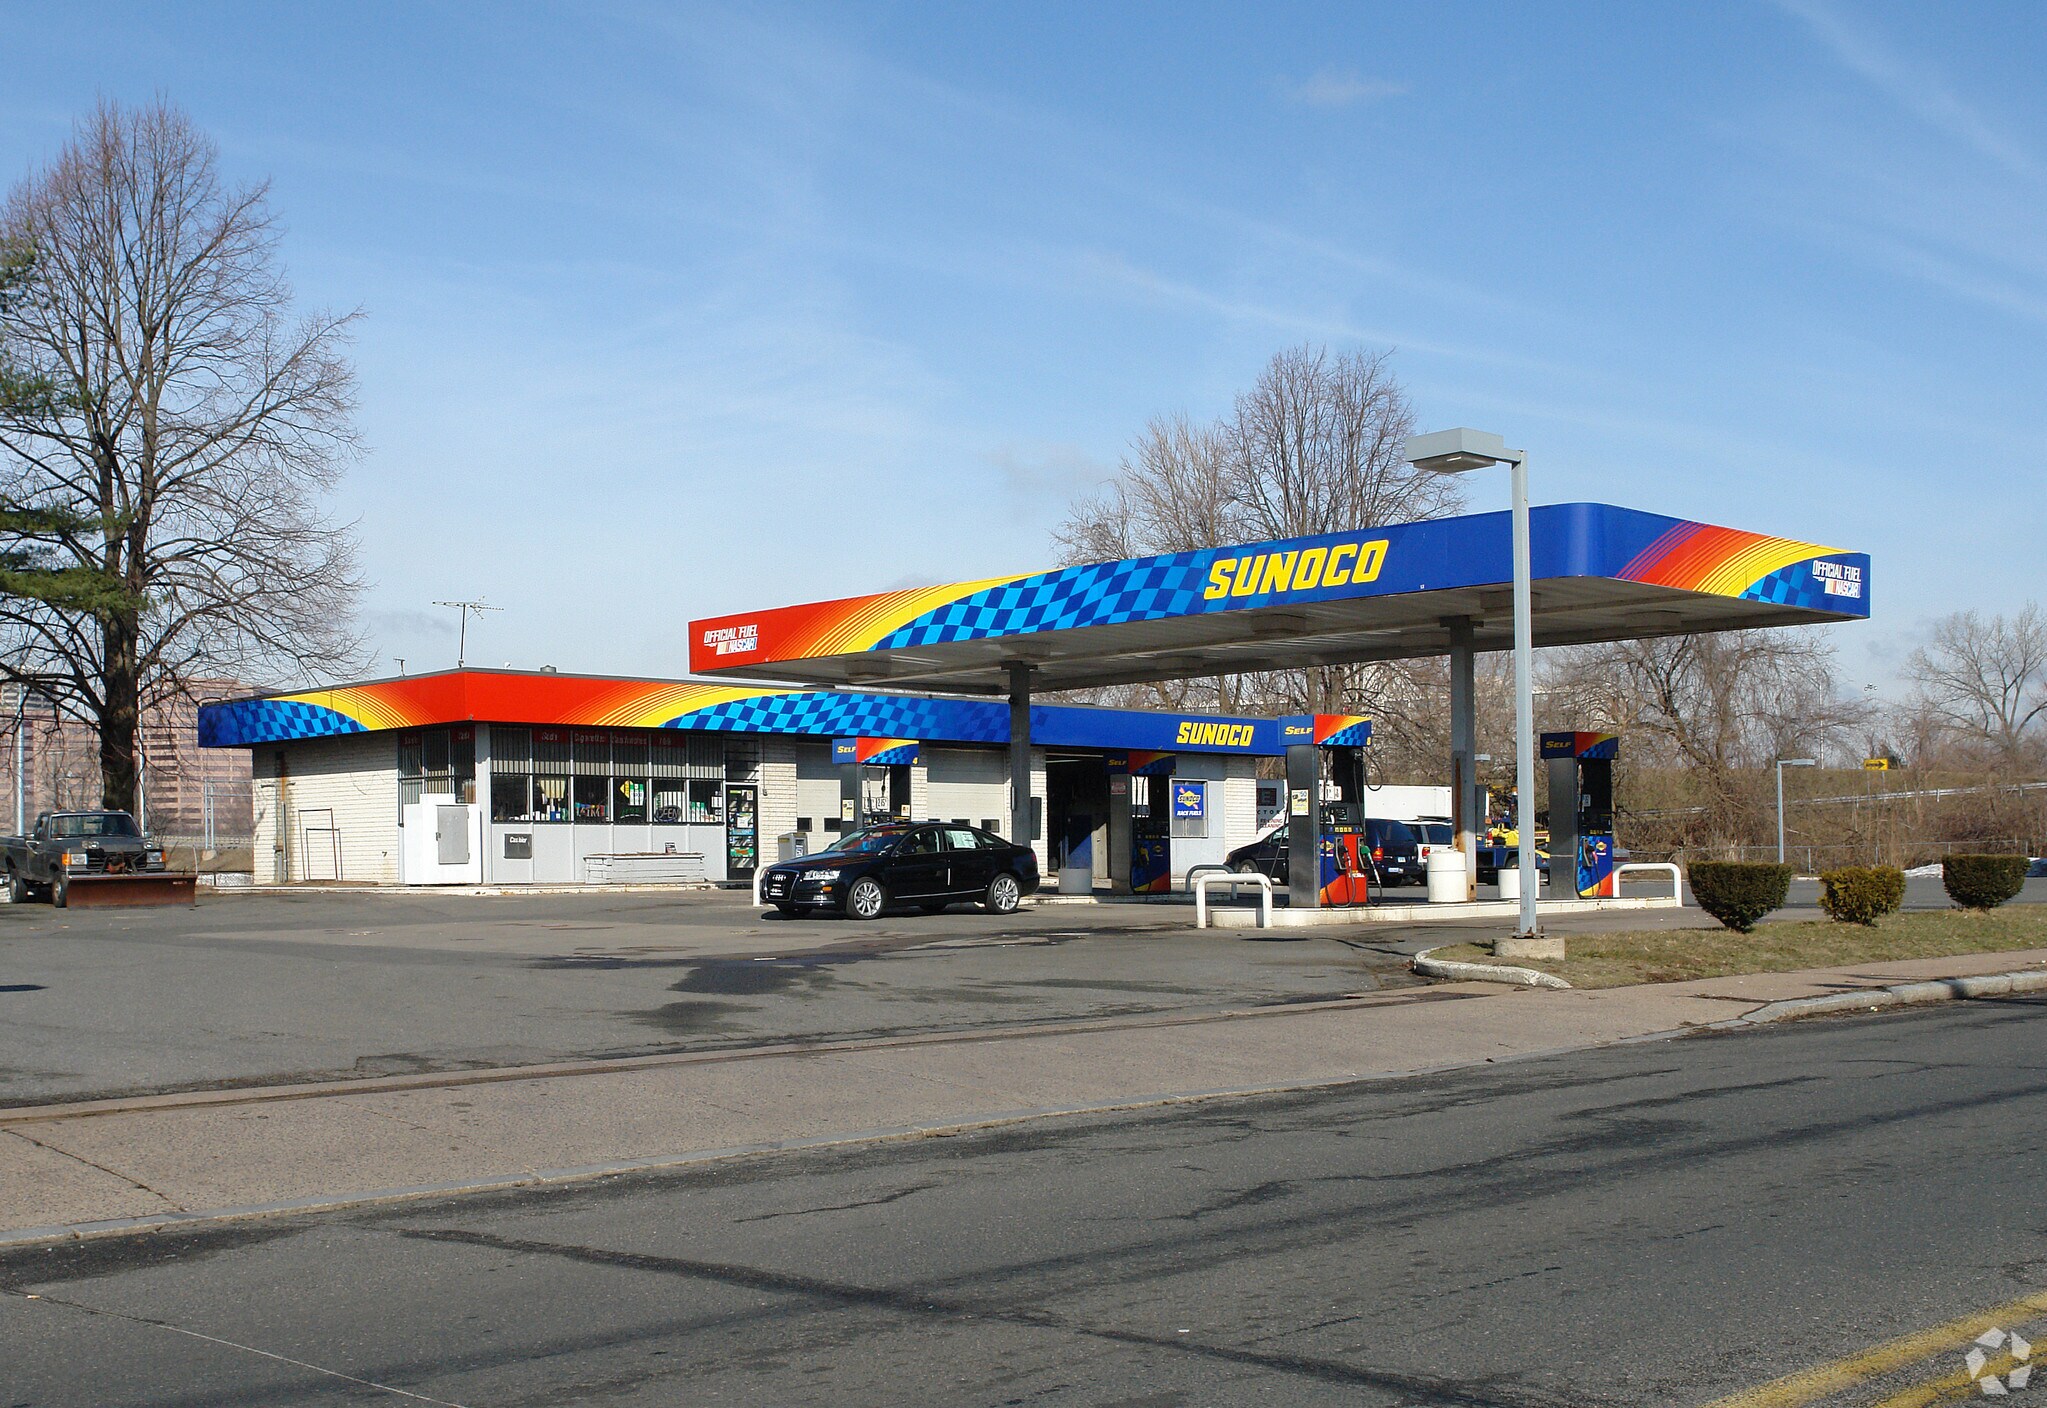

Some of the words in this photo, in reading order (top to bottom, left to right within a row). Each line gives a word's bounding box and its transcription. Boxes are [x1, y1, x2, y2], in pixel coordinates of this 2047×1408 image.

[1204, 539, 1390, 601] SUNOCO
[1812, 560, 1843, 580] OFFICIAL
[1843, 565, 1861, 582] FUEL
[704, 627, 737, 643] OFFICIAL
[738, 624, 758, 639] FUEL
[728, 637, 758, 652] NASCAR
[1176, 721, 1254, 747] SUNOCO
[837, 745, 856, 754] SELF
[912, 757, 918, 765] 4
